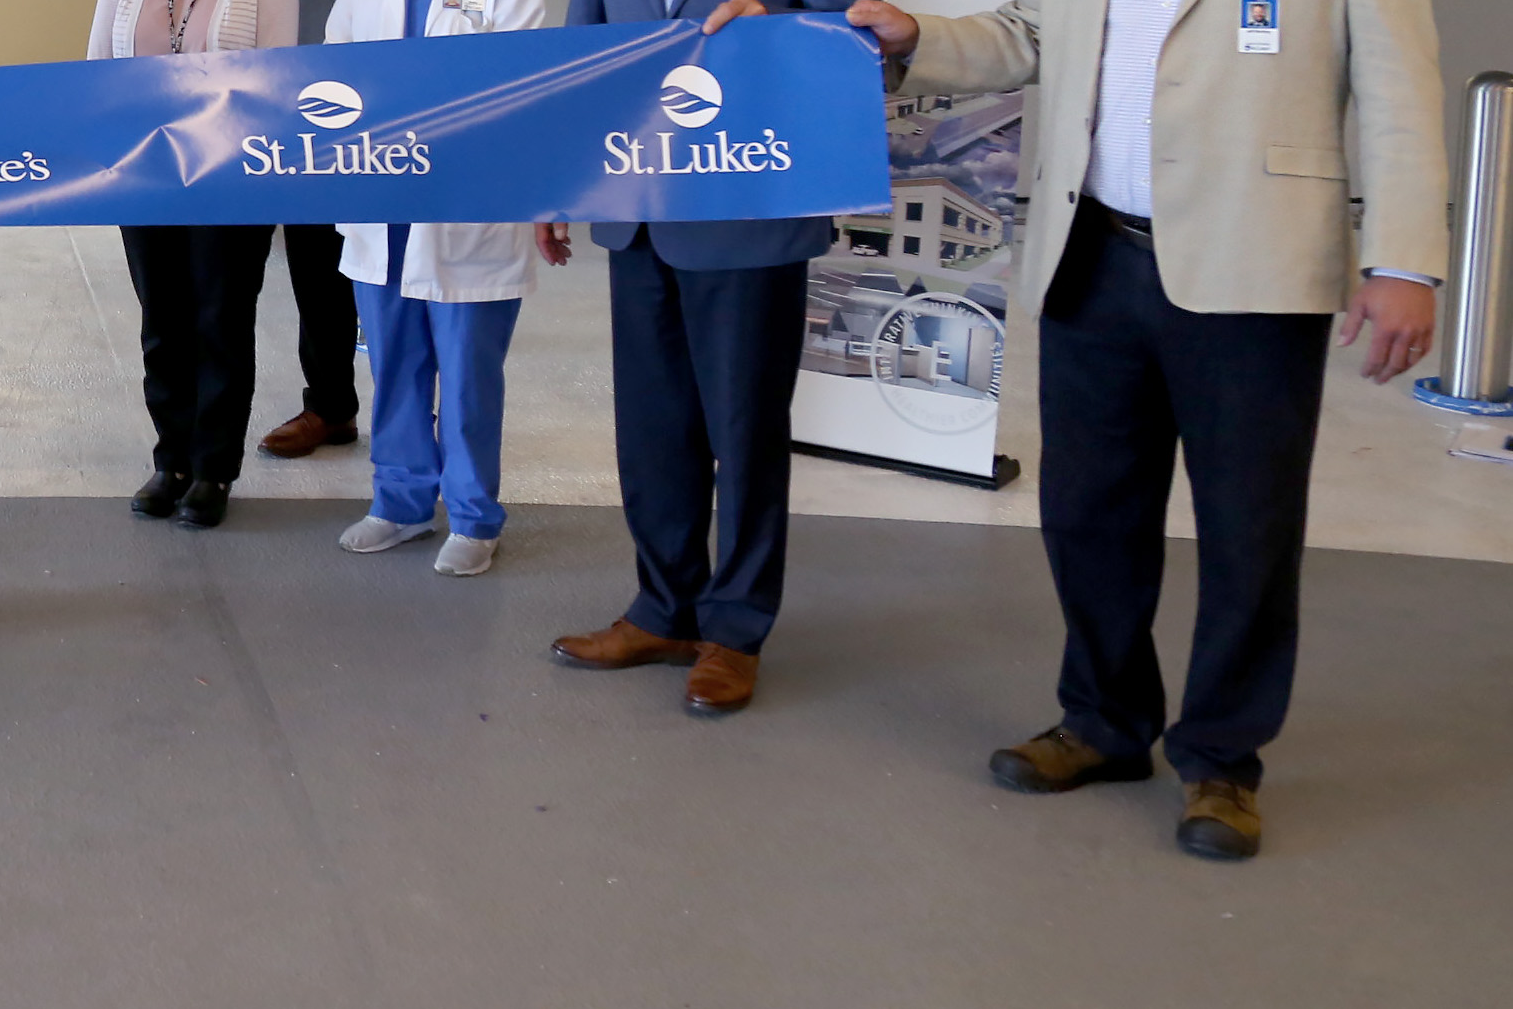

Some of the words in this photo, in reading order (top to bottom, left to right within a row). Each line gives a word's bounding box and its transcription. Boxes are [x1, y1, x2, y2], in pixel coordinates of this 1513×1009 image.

[243, 134, 297, 175] St.
[298, 130, 431, 175] Luke's
[605, 131, 655, 175] St.
[656, 128, 792, 174] Luke's
